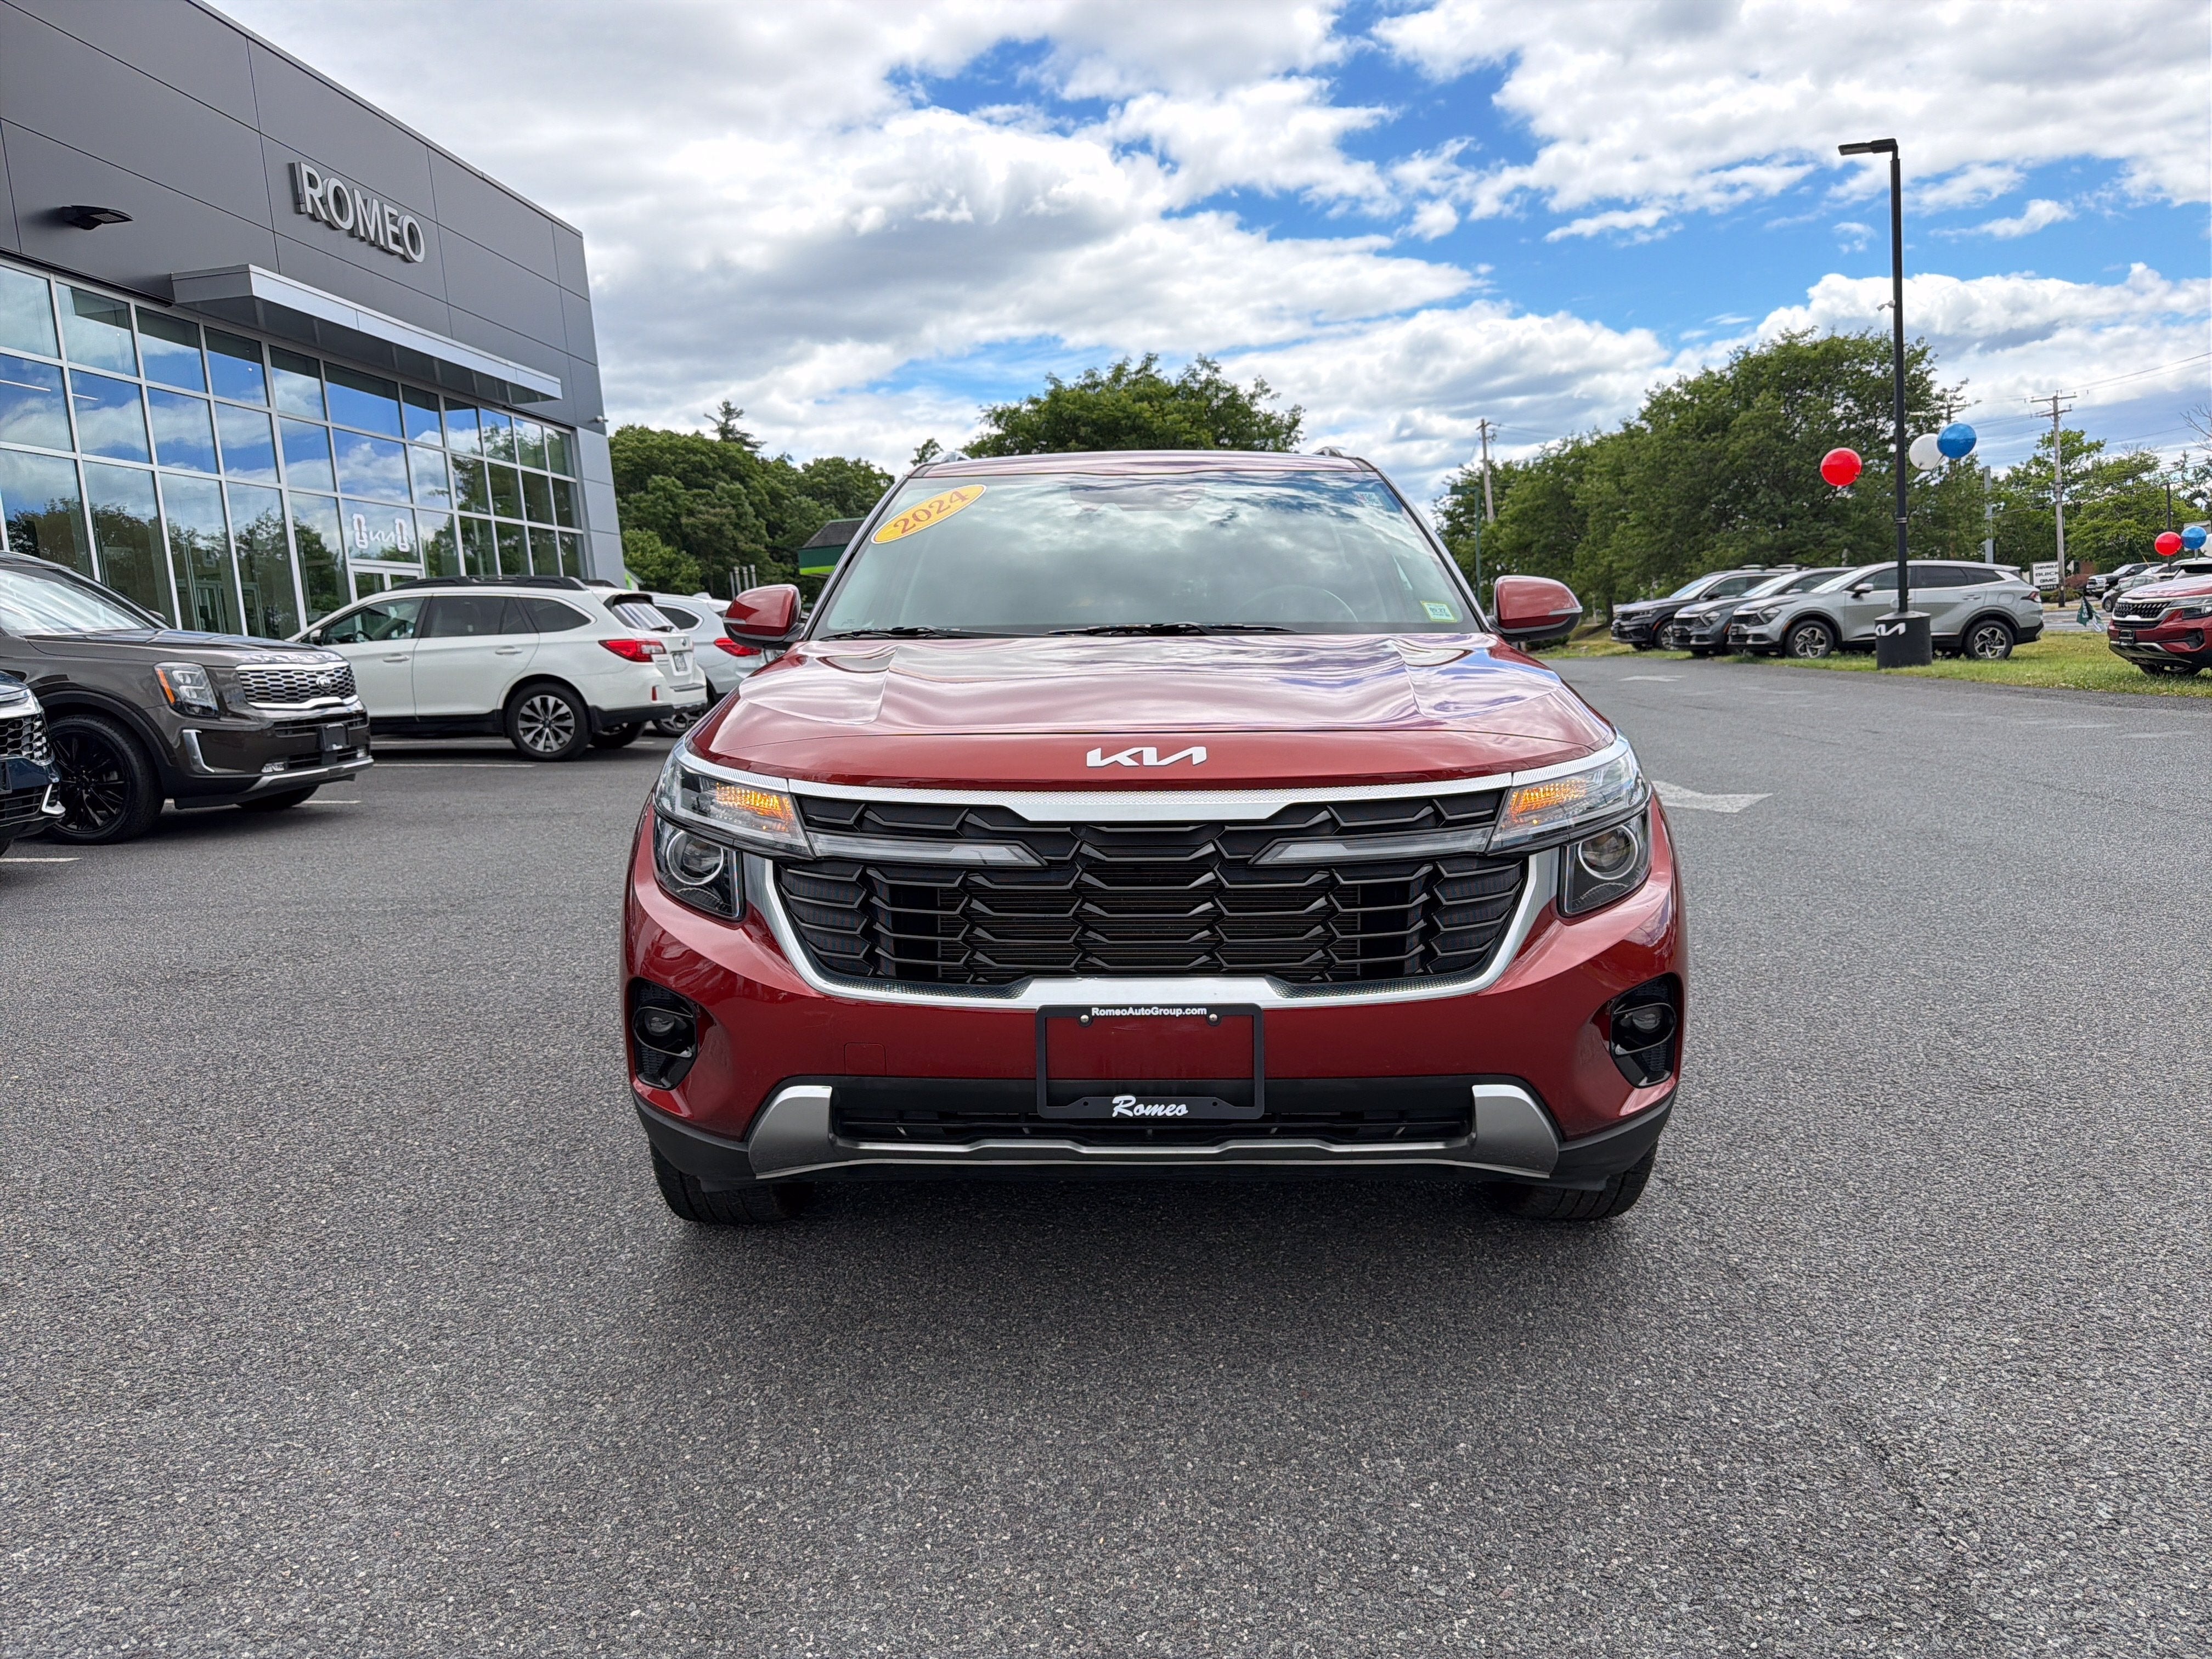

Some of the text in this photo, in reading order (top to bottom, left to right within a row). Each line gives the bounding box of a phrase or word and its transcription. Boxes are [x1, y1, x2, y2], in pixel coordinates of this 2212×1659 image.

[300, 161, 425, 263] ROMEO
[893, 490, 969, 534] 2024
[1087, 746, 1207, 767] KIA
[1091, 1006, 1207, 1017] RomeoAutoGroup.com
[1112, 1095, 1189, 1118] Romeo
